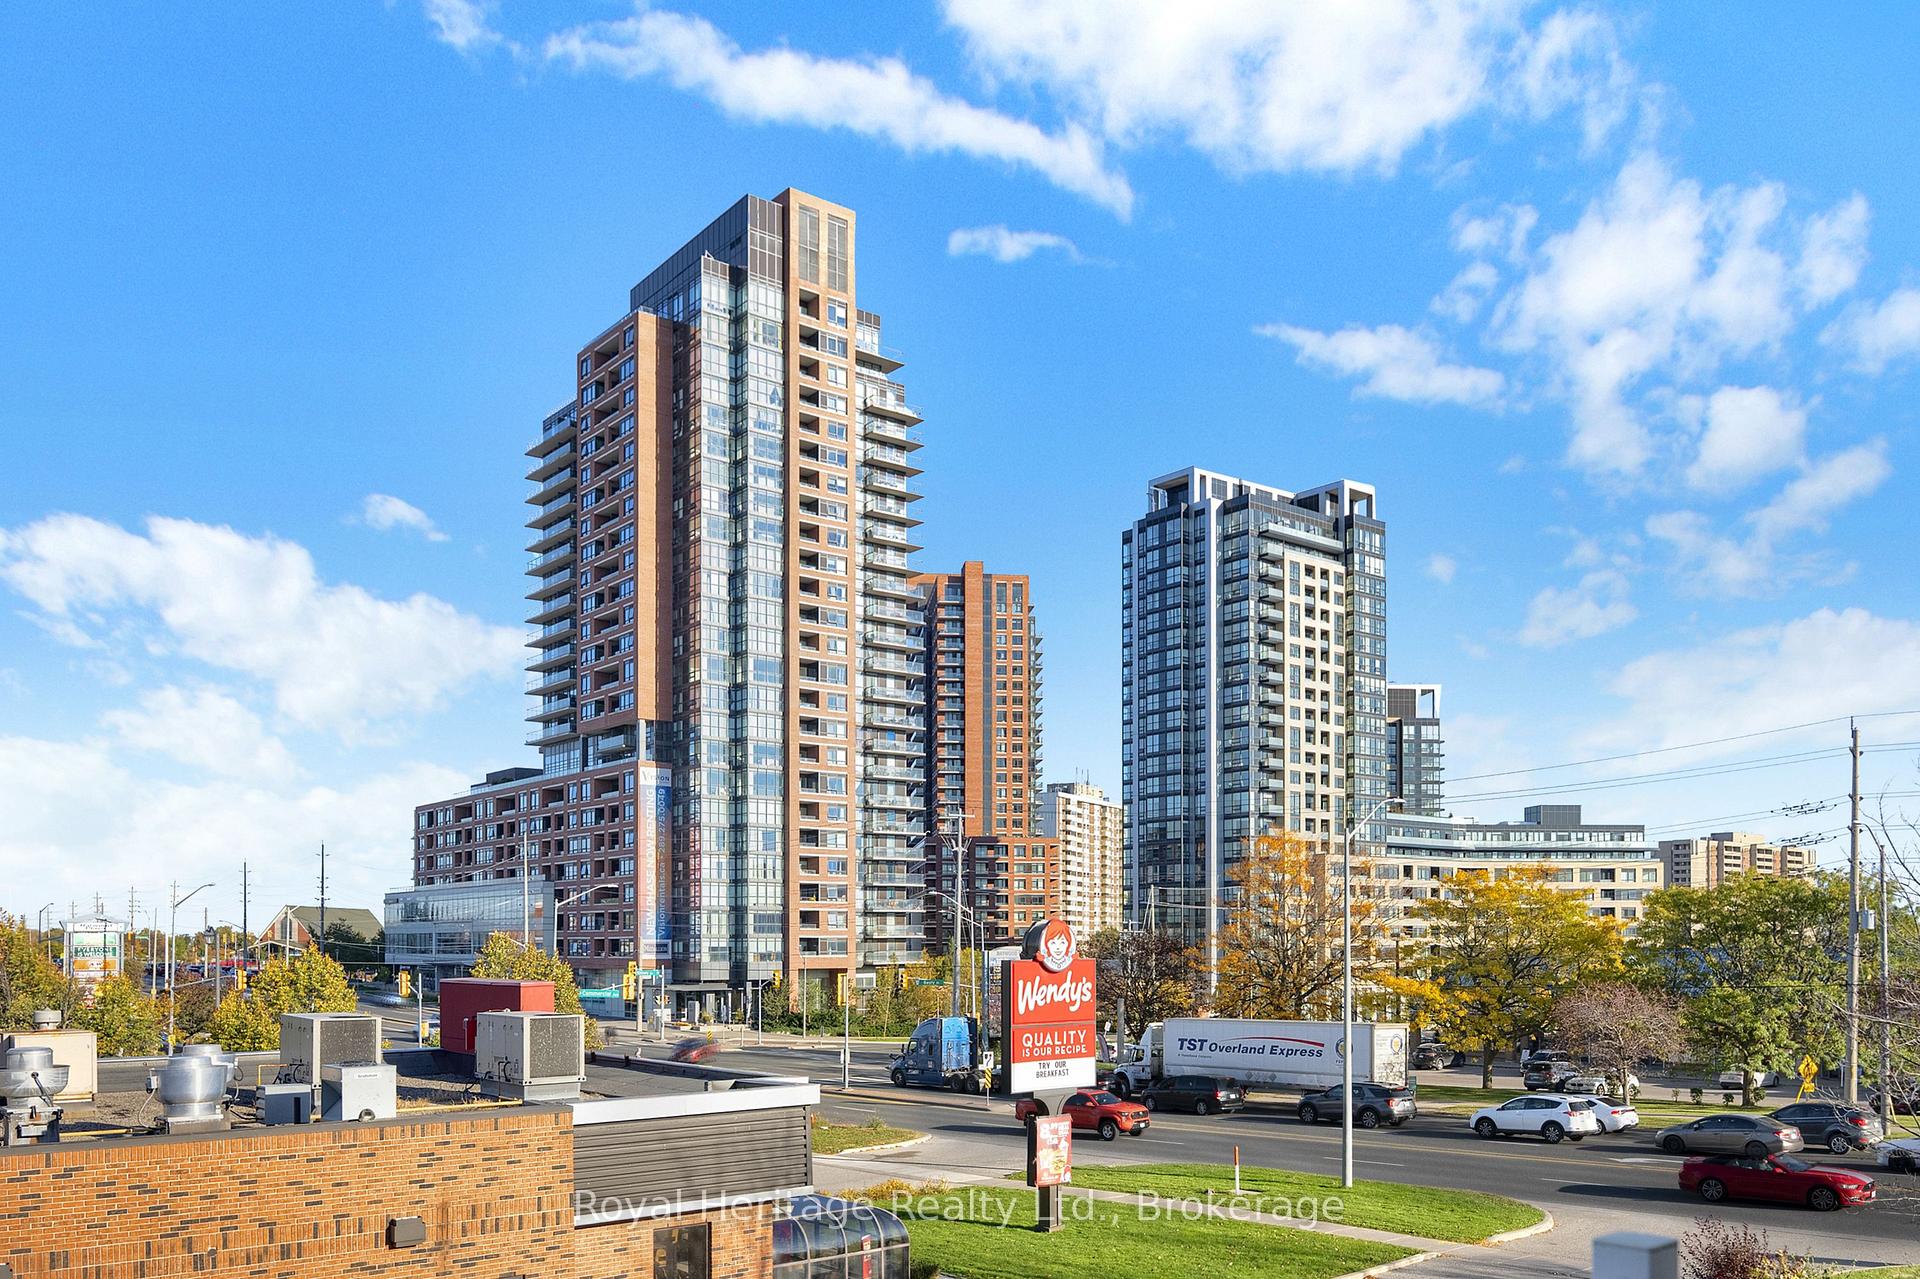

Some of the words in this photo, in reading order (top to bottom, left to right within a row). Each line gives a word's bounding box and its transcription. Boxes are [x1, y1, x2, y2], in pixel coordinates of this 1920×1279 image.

[646, 788, 656, 836] RENTING
[646, 839, 656, 869] NOW
[646, 870, 656, 906] PHASE
[646, 908, 656, 936] NEW
[1017, 970, 1093, 1015] Wendy's
[1022, 1029, 1087, 1048] QUALITY
[1177, 1038, 1208, 1052] TST
[1208, 1042, 1265, 1055] Overland
[1269, 1045, 1323, 1058] Express
[1022, 1049, 1030, 1057] IS
[1033, 1047, 1052, 1057] OUR
[1036, 1068, 1069, 1079] BREAKFAST
[1038, 1062, 1050, 1070] TRY
[1055, 1060, 1067, 1069] OUR
